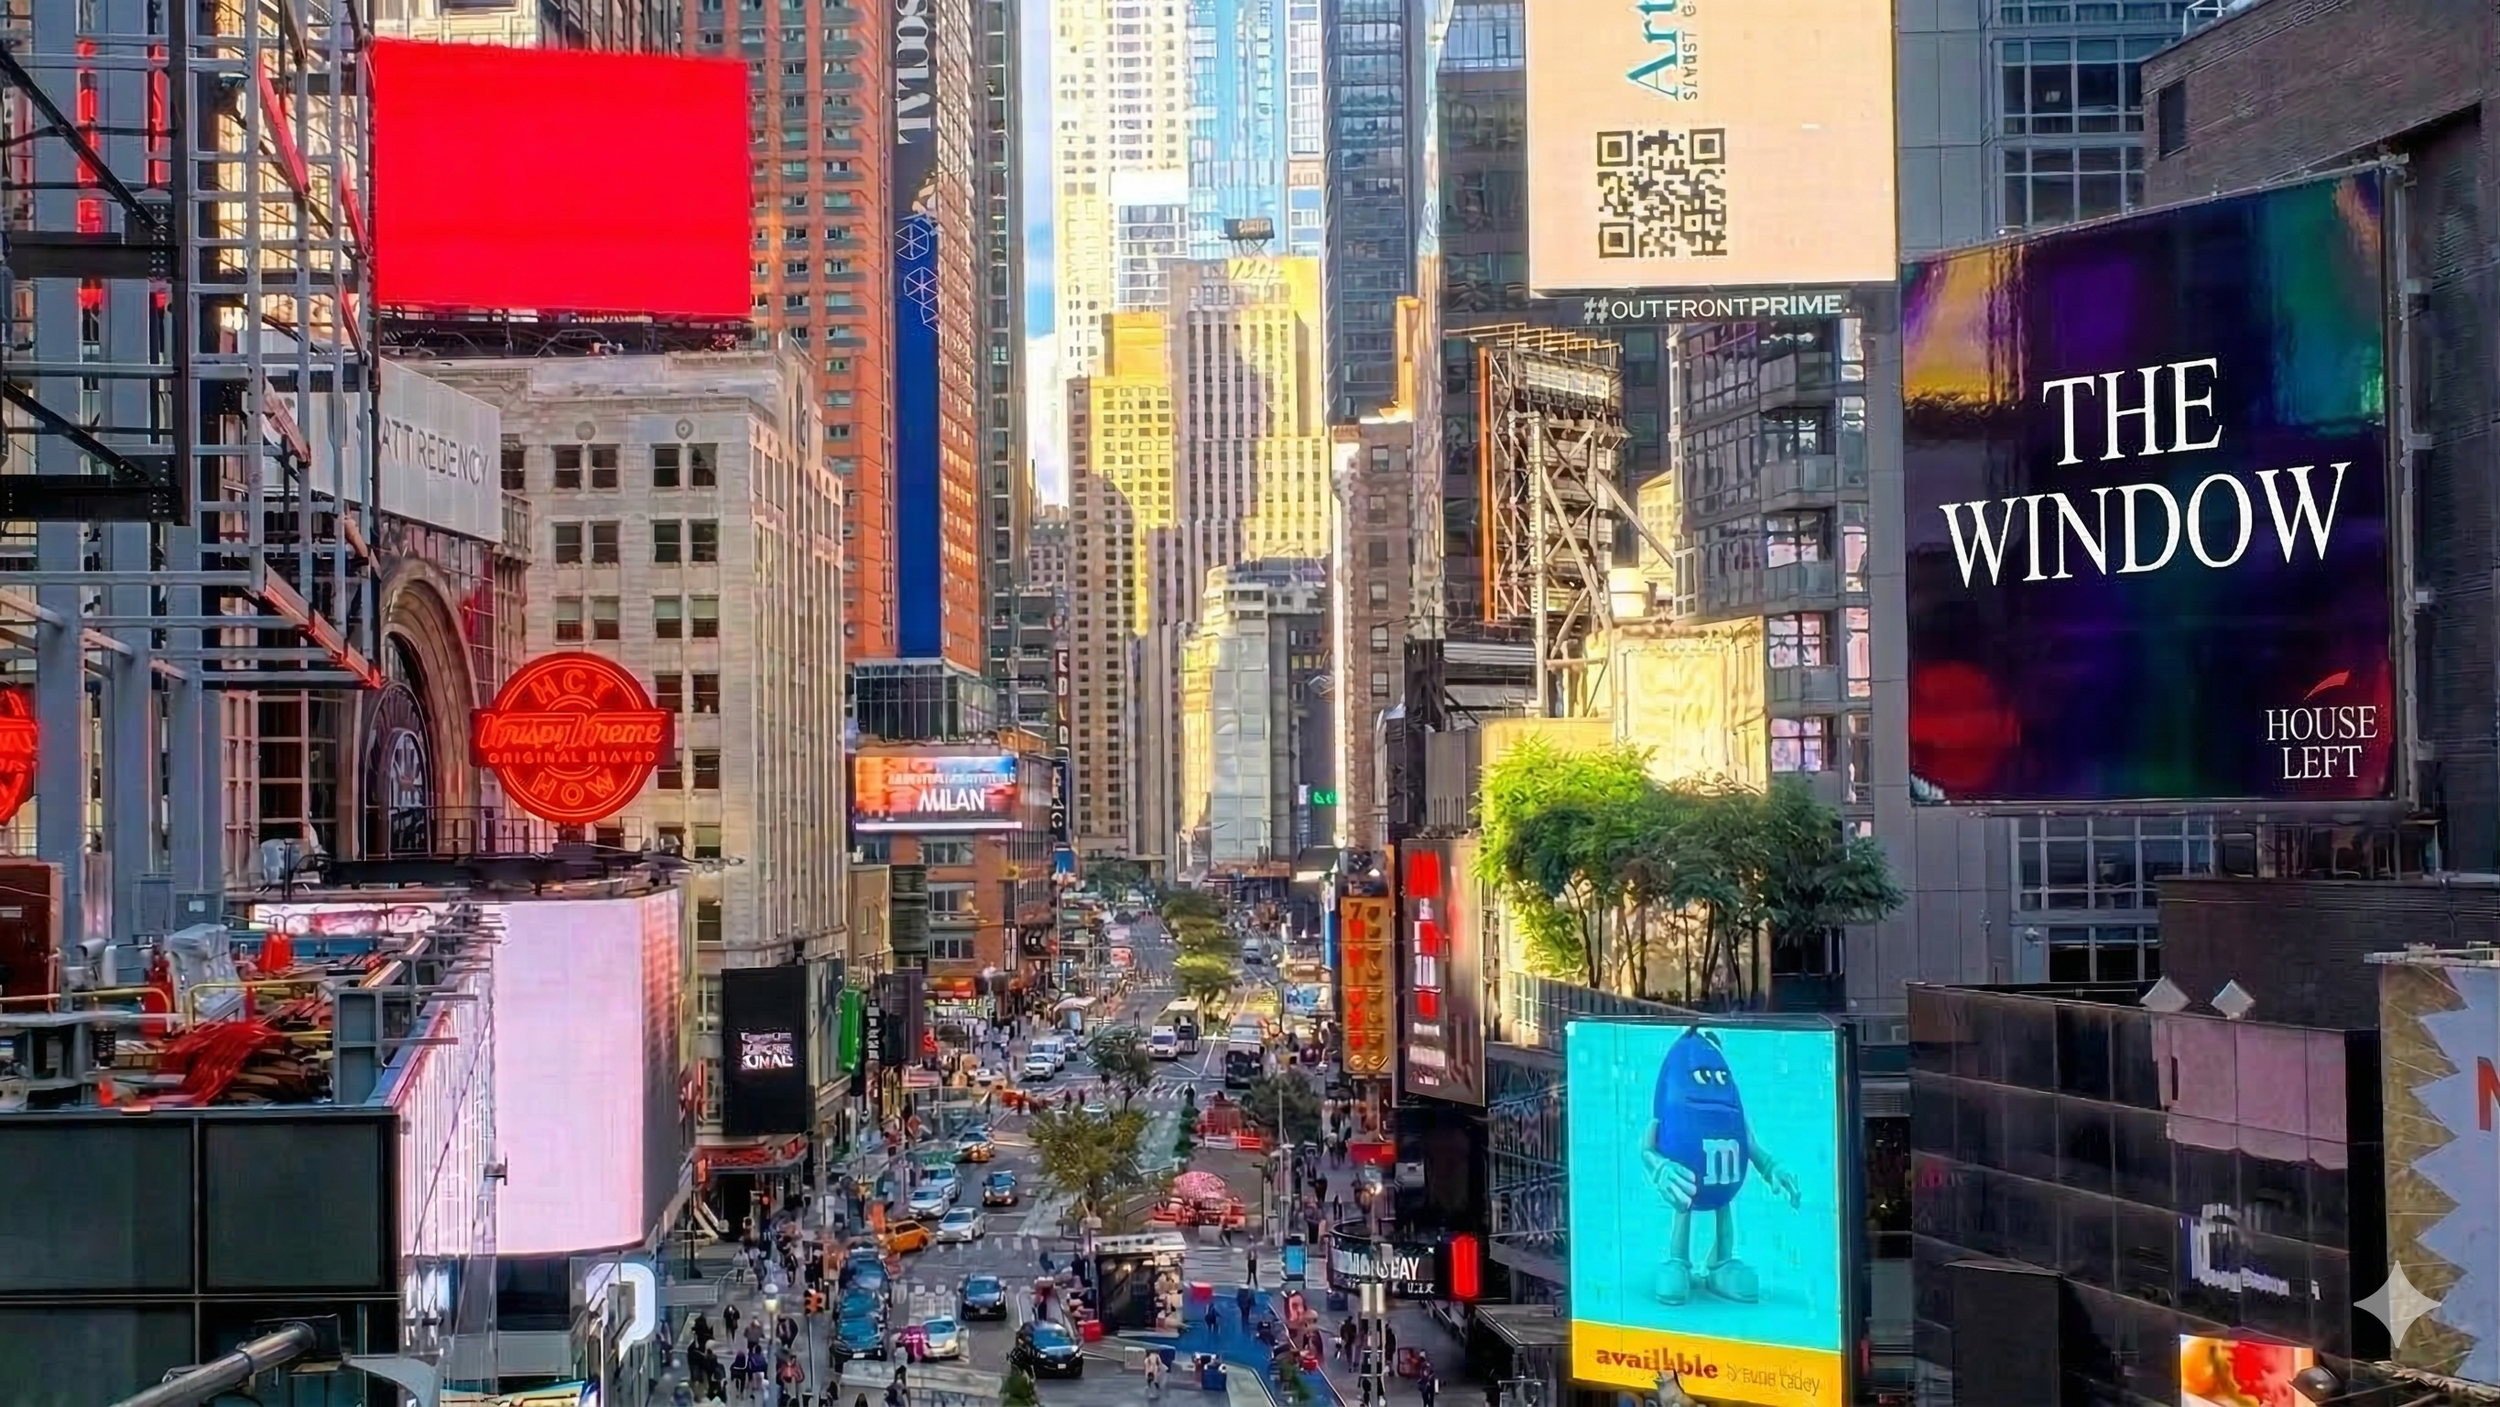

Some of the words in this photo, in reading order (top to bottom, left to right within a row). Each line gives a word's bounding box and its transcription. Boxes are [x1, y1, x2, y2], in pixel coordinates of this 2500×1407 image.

[2043, 357, 2224, 466] THE
[1938, 462, 2352, 589] WINDOW
[2265, 706, 2378, 741] HOUSE
[488, 751, 581, 764] ORIGINAL
[2282, 745, 2363, 779] LEFT
[918, 788, 986, 812] MILAN
[1702, 1138, 1740, 1186] m
